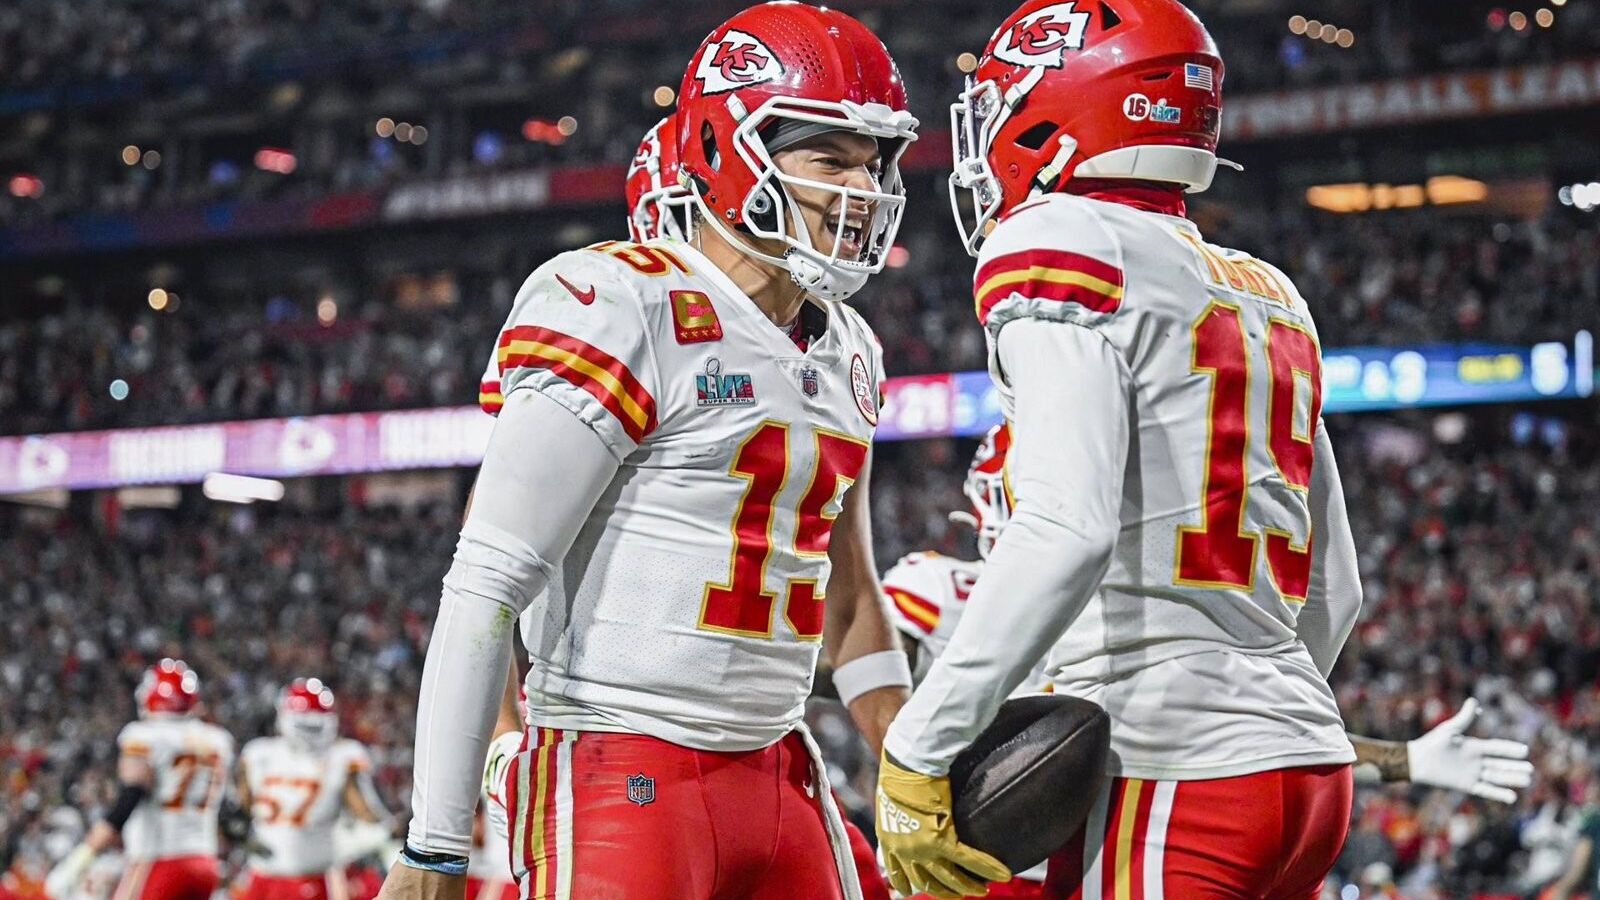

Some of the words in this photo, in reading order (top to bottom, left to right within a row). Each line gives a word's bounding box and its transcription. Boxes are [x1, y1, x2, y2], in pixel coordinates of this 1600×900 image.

[1009, 16, 1070, 55] KC
[710, 41, 769, 82] KC
[1491, 61, 1600, 104] LEA
[1127, 97, 1147, 117] 16
[676, 294, 716, 329] C
[1173, 299, 1323, 605] 19
[696, 418, 870, 641] 15
[253, 776, 322, 827] 57
